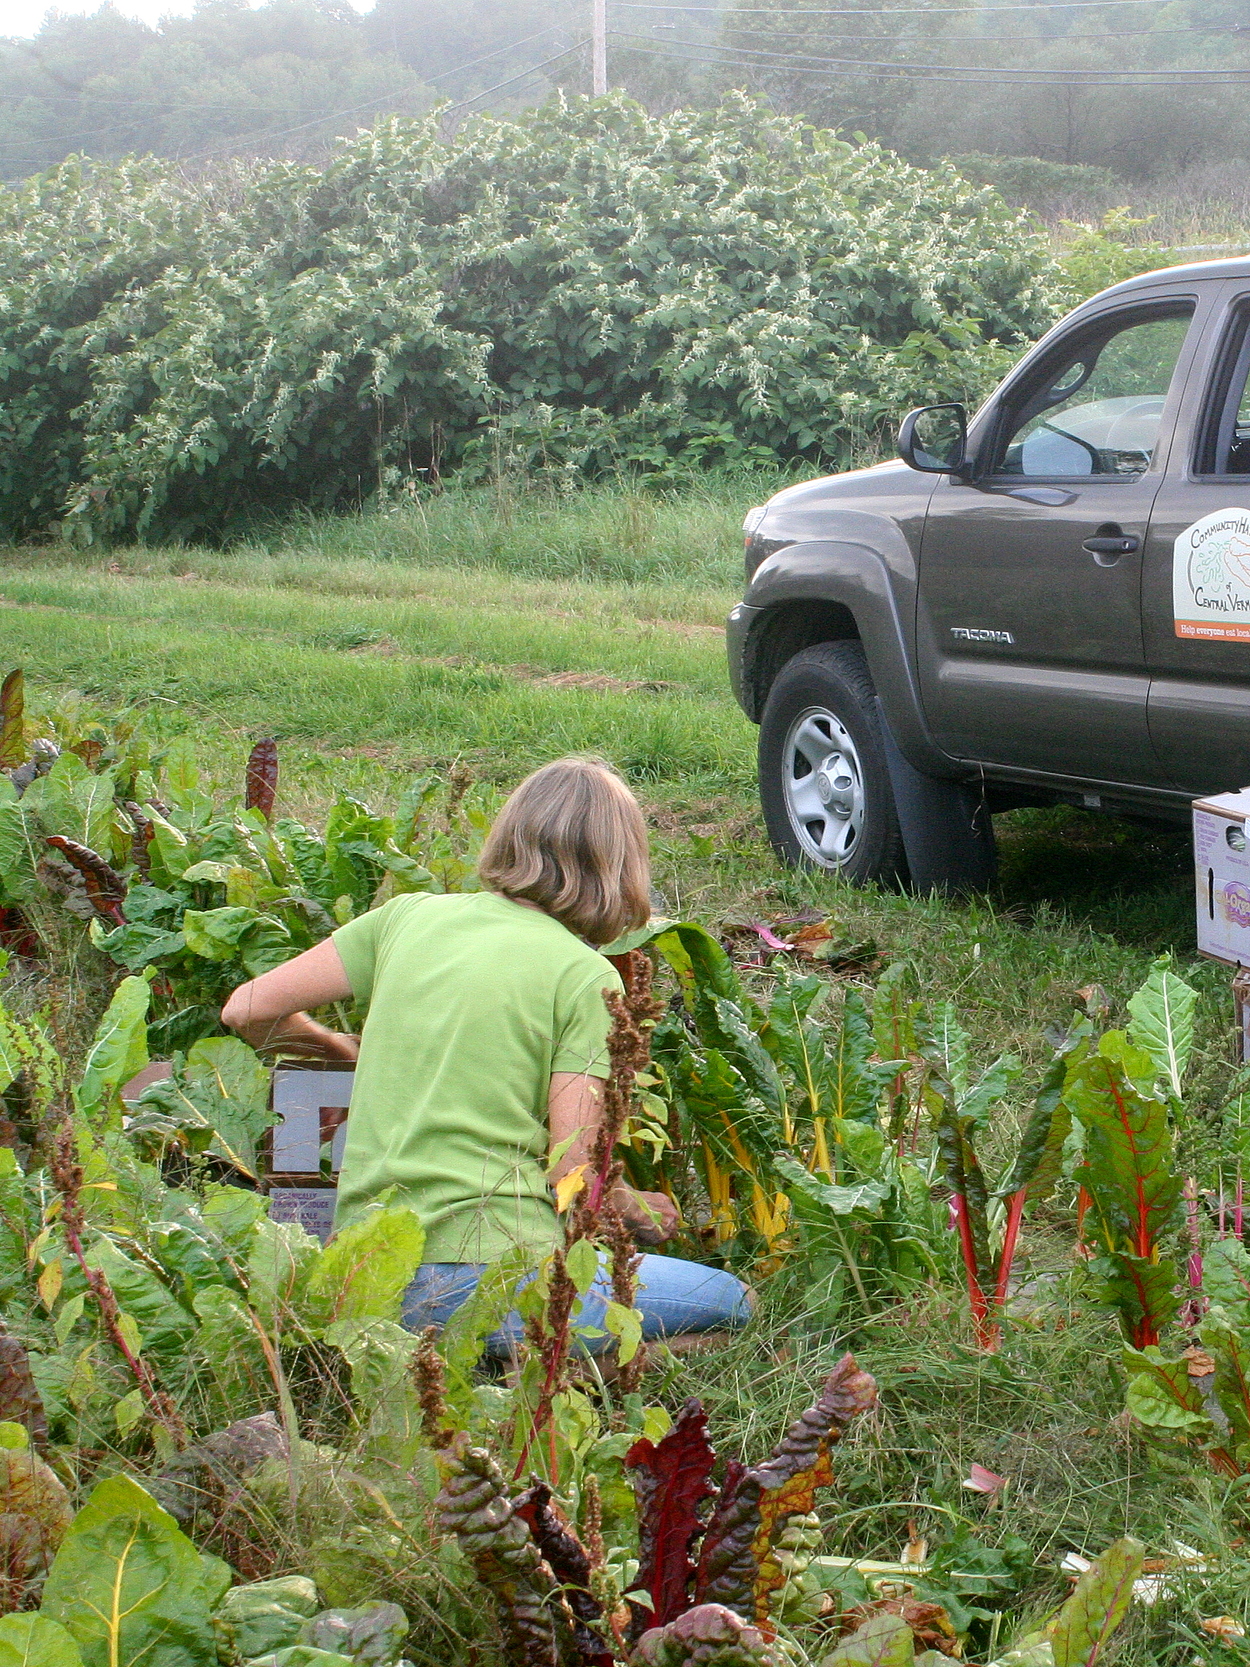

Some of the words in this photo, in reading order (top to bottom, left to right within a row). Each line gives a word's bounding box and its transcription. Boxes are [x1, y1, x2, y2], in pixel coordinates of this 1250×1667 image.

[1195, 587, 1229, 611] CENTRAL
[950, 627, 1015, 644] TACOMA
[1181, 624, 1195, 636] Help
[1196, 627, 1225, 637] everyone
